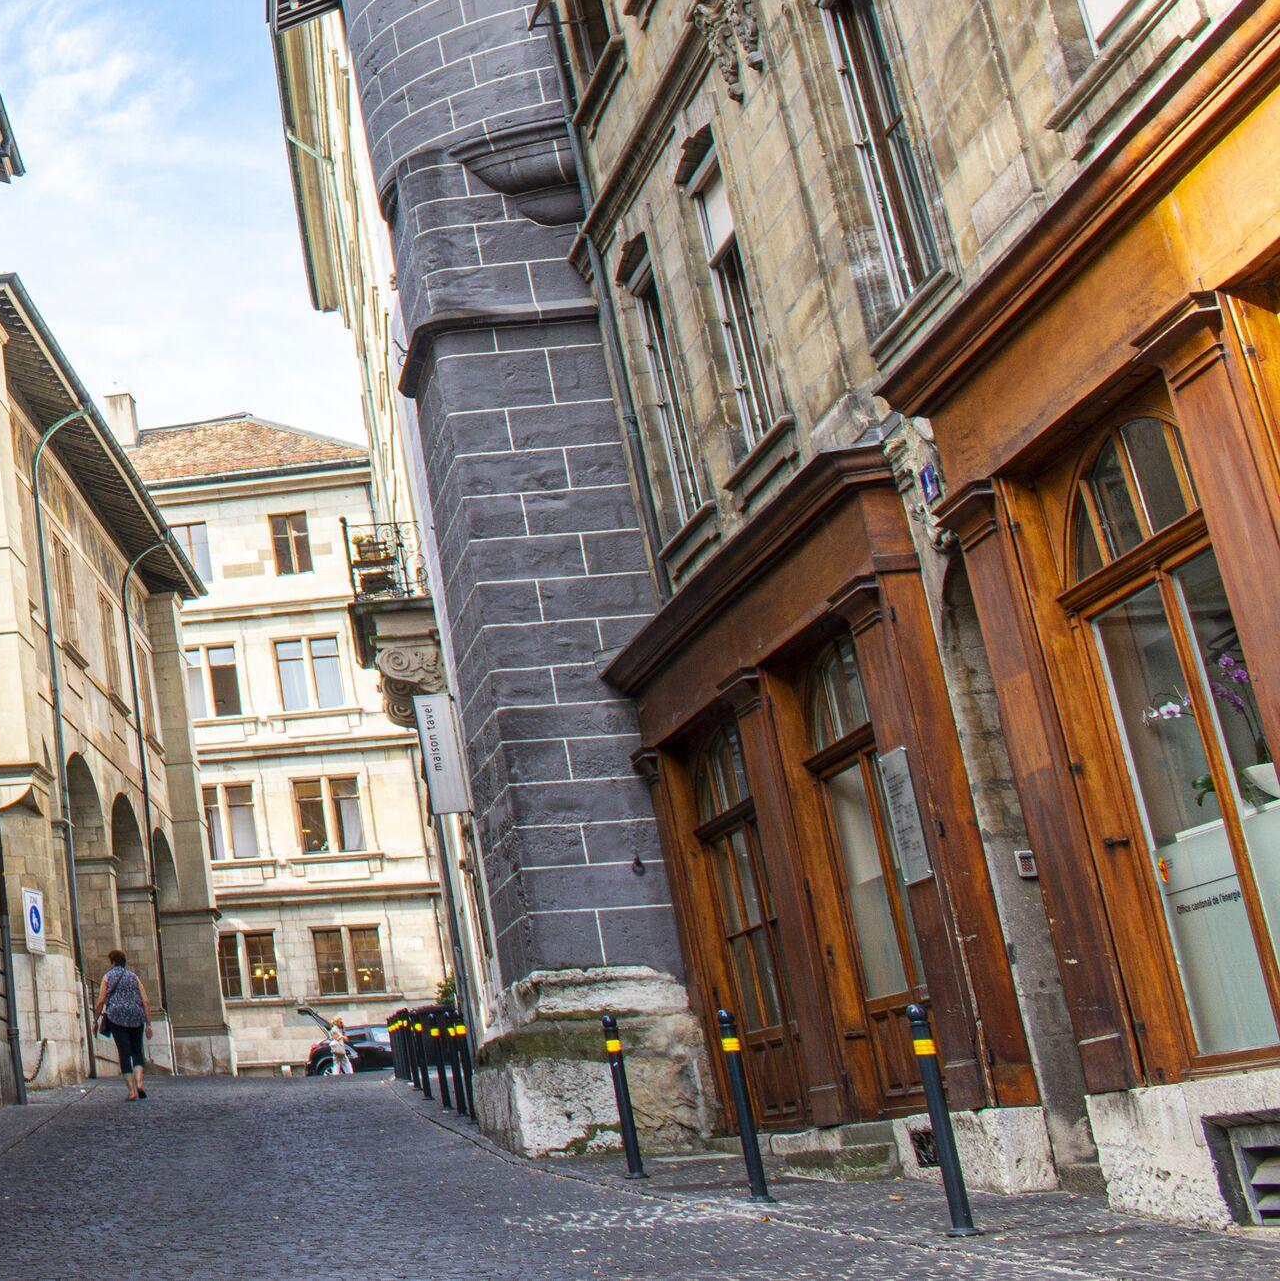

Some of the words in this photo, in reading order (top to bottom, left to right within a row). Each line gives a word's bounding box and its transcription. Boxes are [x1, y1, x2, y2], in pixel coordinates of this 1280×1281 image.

[421, 703, 436, 730] tavel
[430, 733, 443, 771] maison
[1176, 903, 1191, 915] Office
[1191, 896, 1212, 911] cantonal
[1212, 895, 1220, 905] de
